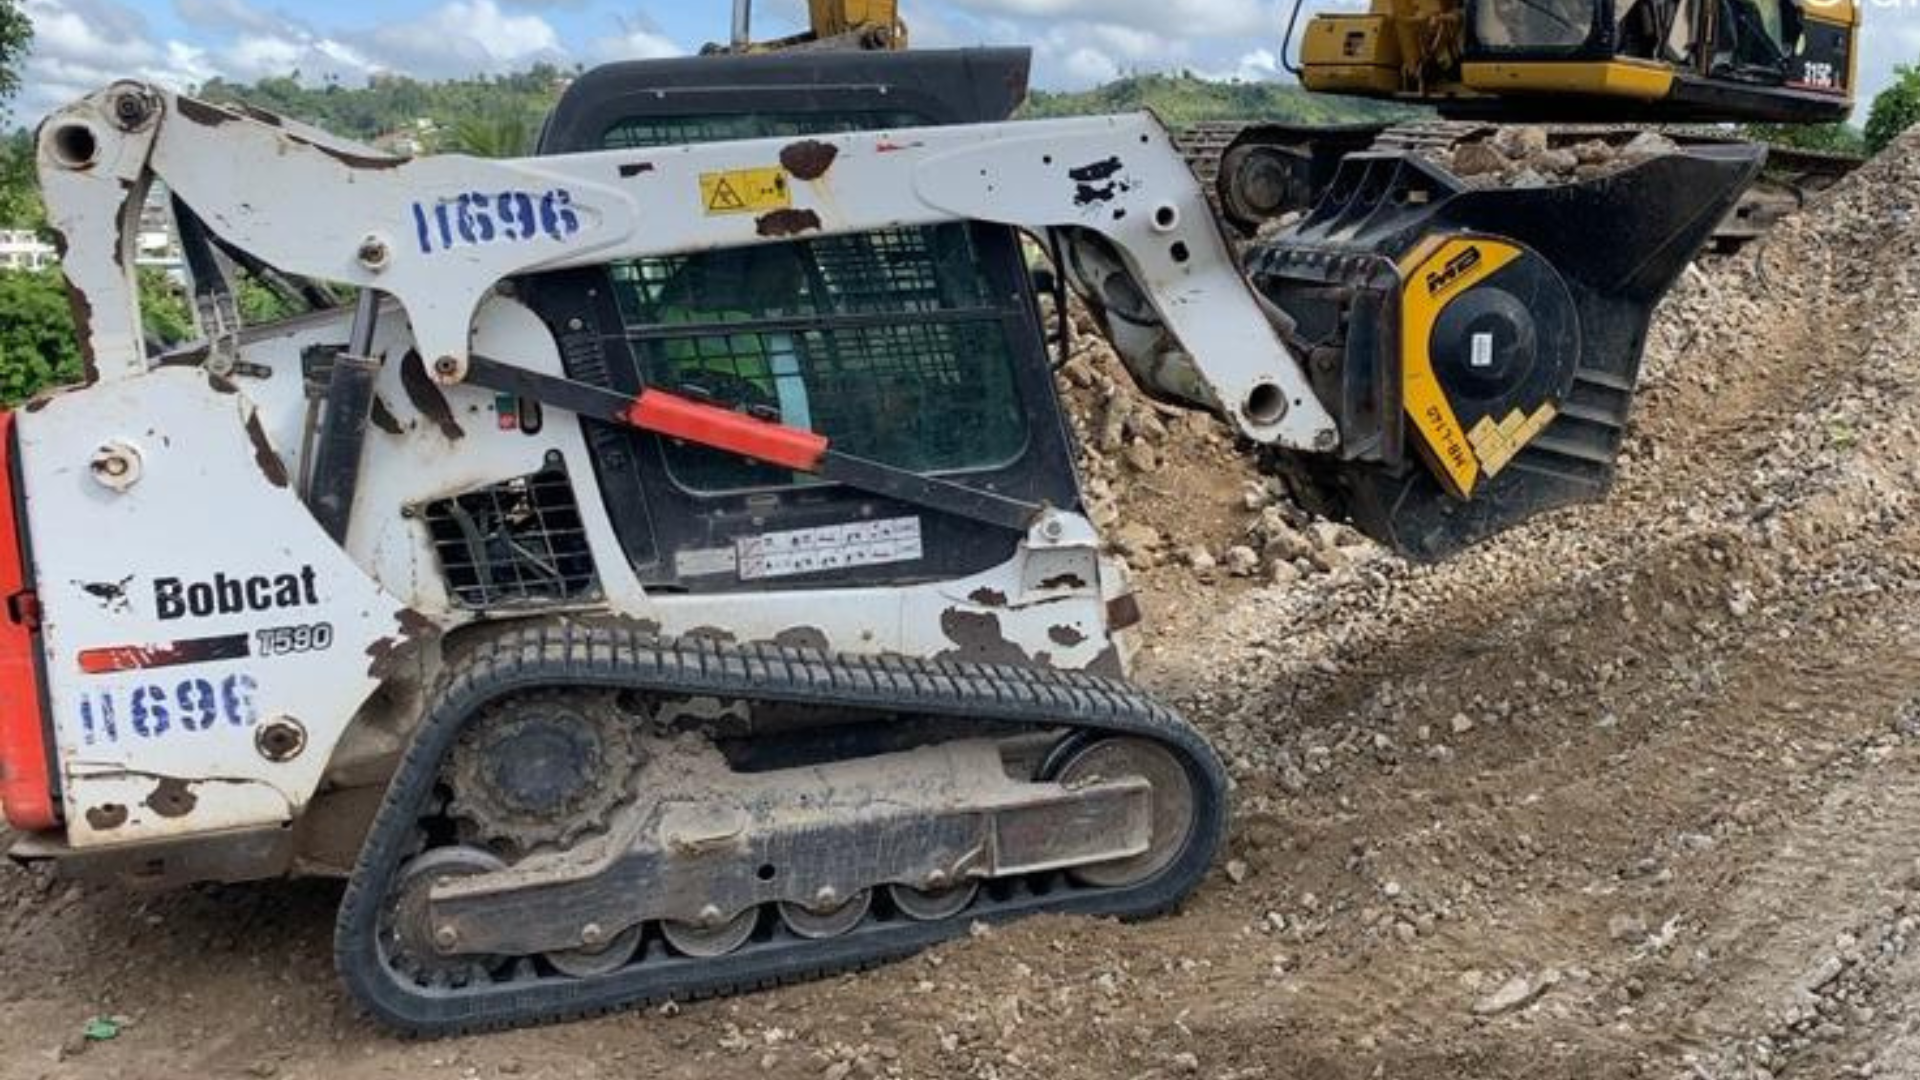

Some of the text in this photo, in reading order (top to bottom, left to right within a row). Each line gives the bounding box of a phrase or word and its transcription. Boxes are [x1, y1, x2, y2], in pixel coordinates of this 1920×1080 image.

[1804, 61, 1832, 87] 315C
[412, 188, 580, 254] 11696
[153, 564, 320, 621] Bobcat
[255, 621, 333, 656] T590
[78, 673, 259, 745] 11696
